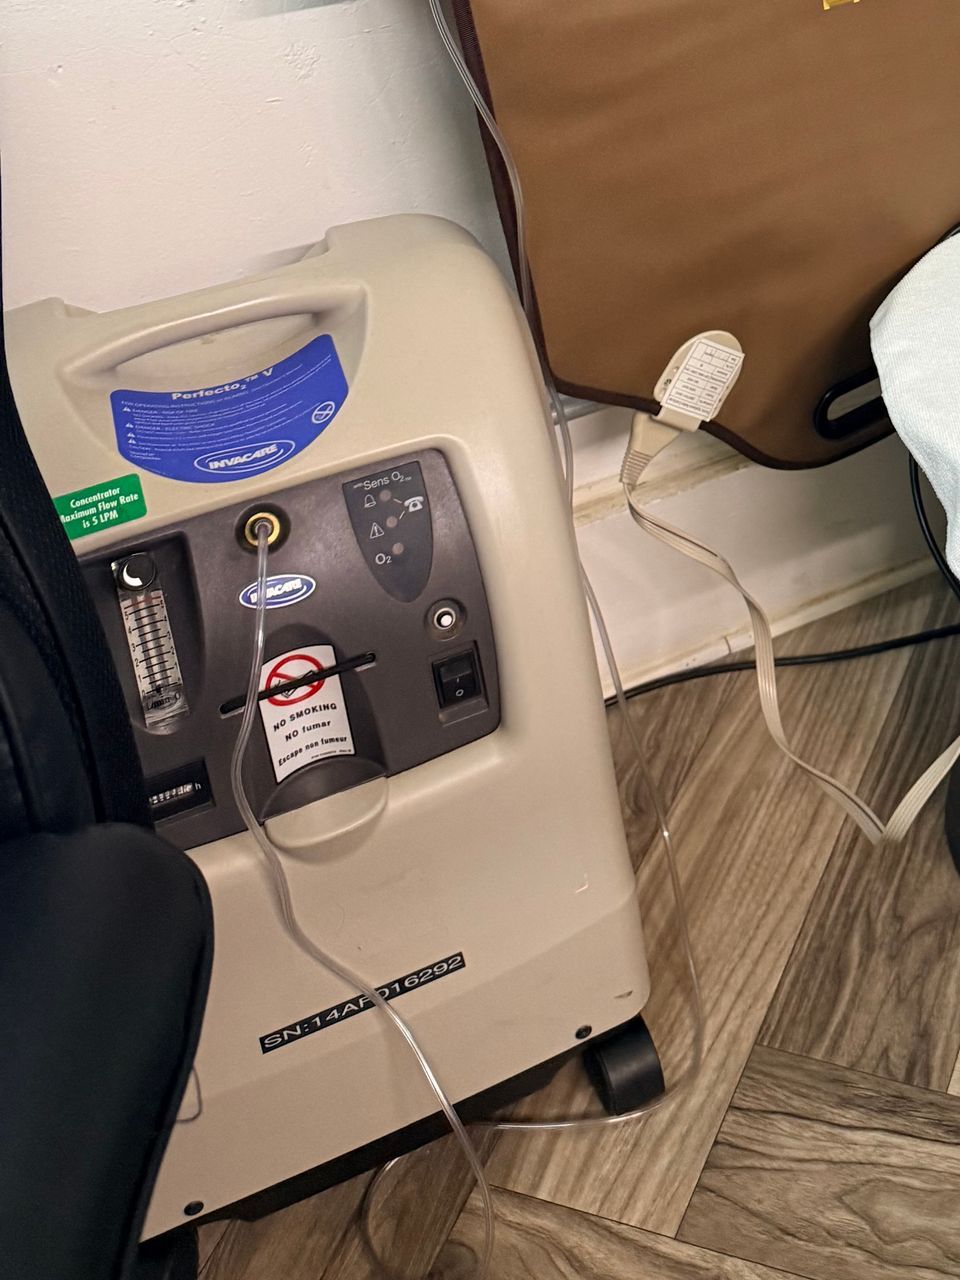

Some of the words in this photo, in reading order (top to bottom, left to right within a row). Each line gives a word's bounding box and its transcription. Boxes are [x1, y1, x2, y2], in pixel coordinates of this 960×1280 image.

[261, 367, 273, 377] V
[208, 444, 278, 470] INVACARE
[363, 476, 390, 491] Sens
[70, 487, 120, 508] Concentrator
[98, 500, 118, 512] Flow
[119, 493, 139, 505] Rate
[82, 520, 91, 529] is
[92, 515, 99, 526] 5
[100, 509, 119, 523] LPM
[131, 642, 136, 652] 3
[134, 658, 140, 668] 2
[273, 719, 286, 732] NO
[289, 703, 337, 721] SMOKING
[285, 729, 299, 742] NO
[302, 720, 331, 733] fumar
[278, 748, 303, 766] Escape
[305, 741, 319, 750] non
[321, 736, 347, 745] fumeur
